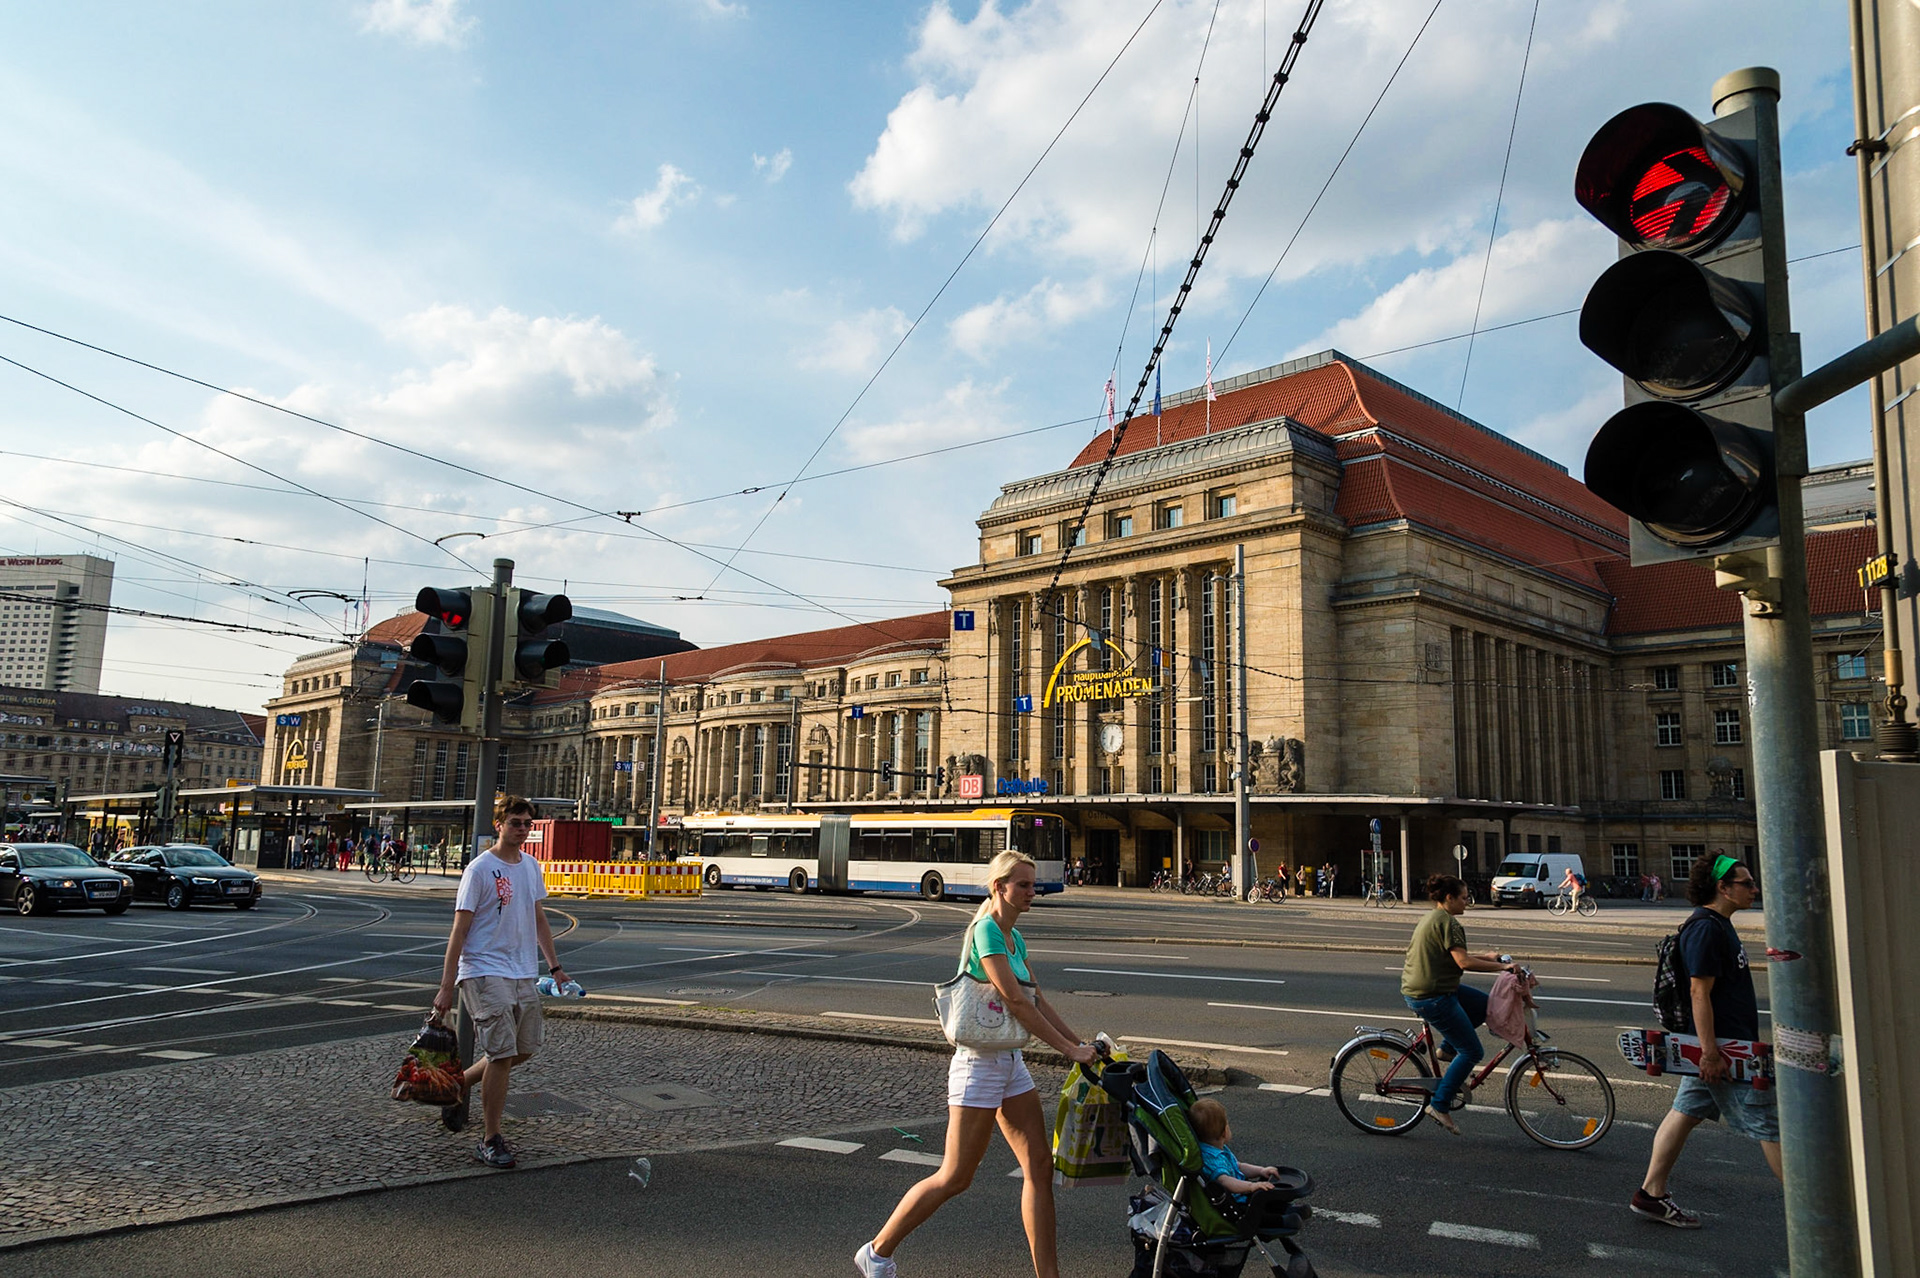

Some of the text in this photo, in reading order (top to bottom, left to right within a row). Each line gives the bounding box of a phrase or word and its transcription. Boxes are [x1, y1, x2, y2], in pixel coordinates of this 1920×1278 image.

[1866, 554, 1888, 581] 1128
[959, 613, 970, 629] T
[1056, 677, 1152, 703] PROMENADEN
[1020, 697, 1029, 710] T
[854, 707, 861, 717] T
[290, 716, 301, 725] W
[962, 779, 979, 794] DB
[996, 777, 1048, 794] Osthalle
